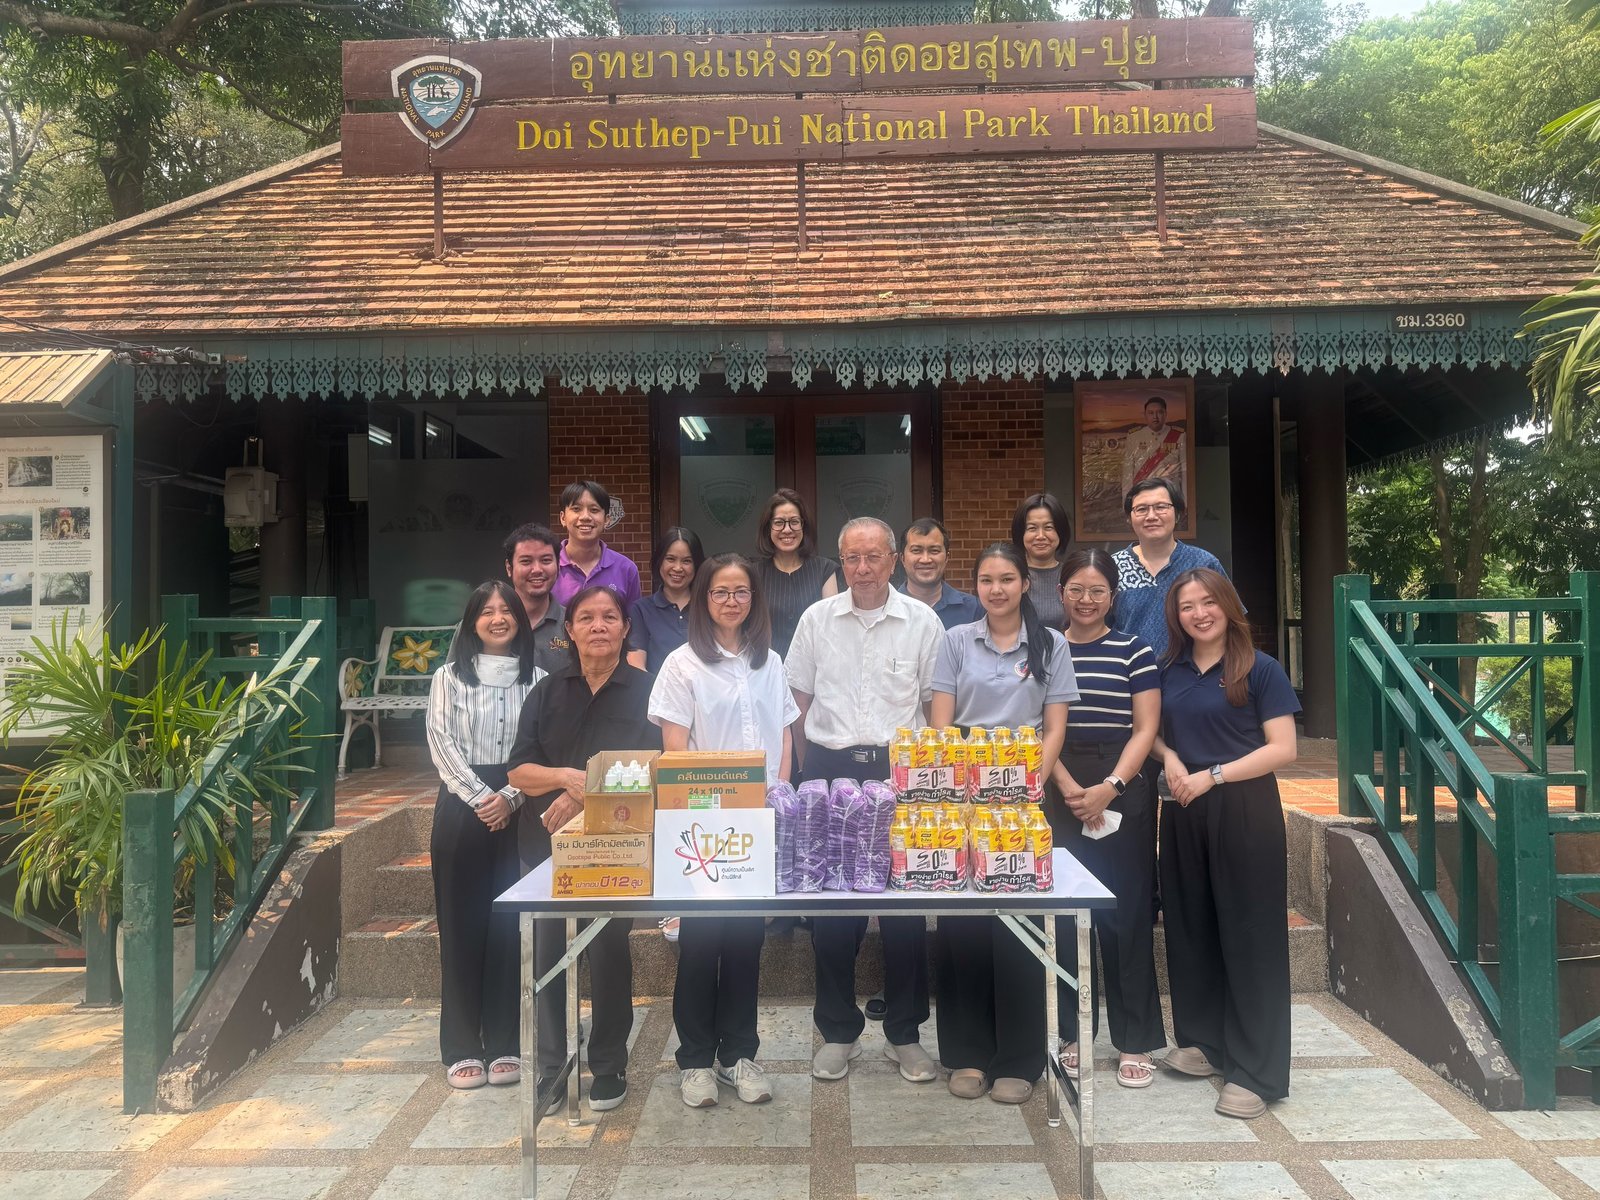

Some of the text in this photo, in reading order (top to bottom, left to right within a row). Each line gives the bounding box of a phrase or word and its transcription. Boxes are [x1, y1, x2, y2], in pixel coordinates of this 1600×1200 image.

[570, 25, 1157, 93] อุทยานแห่งชาติดอยสุเทพ-ปุย
[400, 87, 420, 124] NATIONAL
[452, 87, 472, 122] THAILAND
[425, 129, 446, 139] PARK
[516, 103, 1216, 159] Doi Suthep-Pui National Park Thailand
[1395, 313, 1465, 328] ชม.3360
[677, 770, 749, 781] คลีนแอนด์แคร์
[688, 787, 699, 795] 24
[708, 787, 724, 795] 100
[700, 833, 754, 857] ThEP
